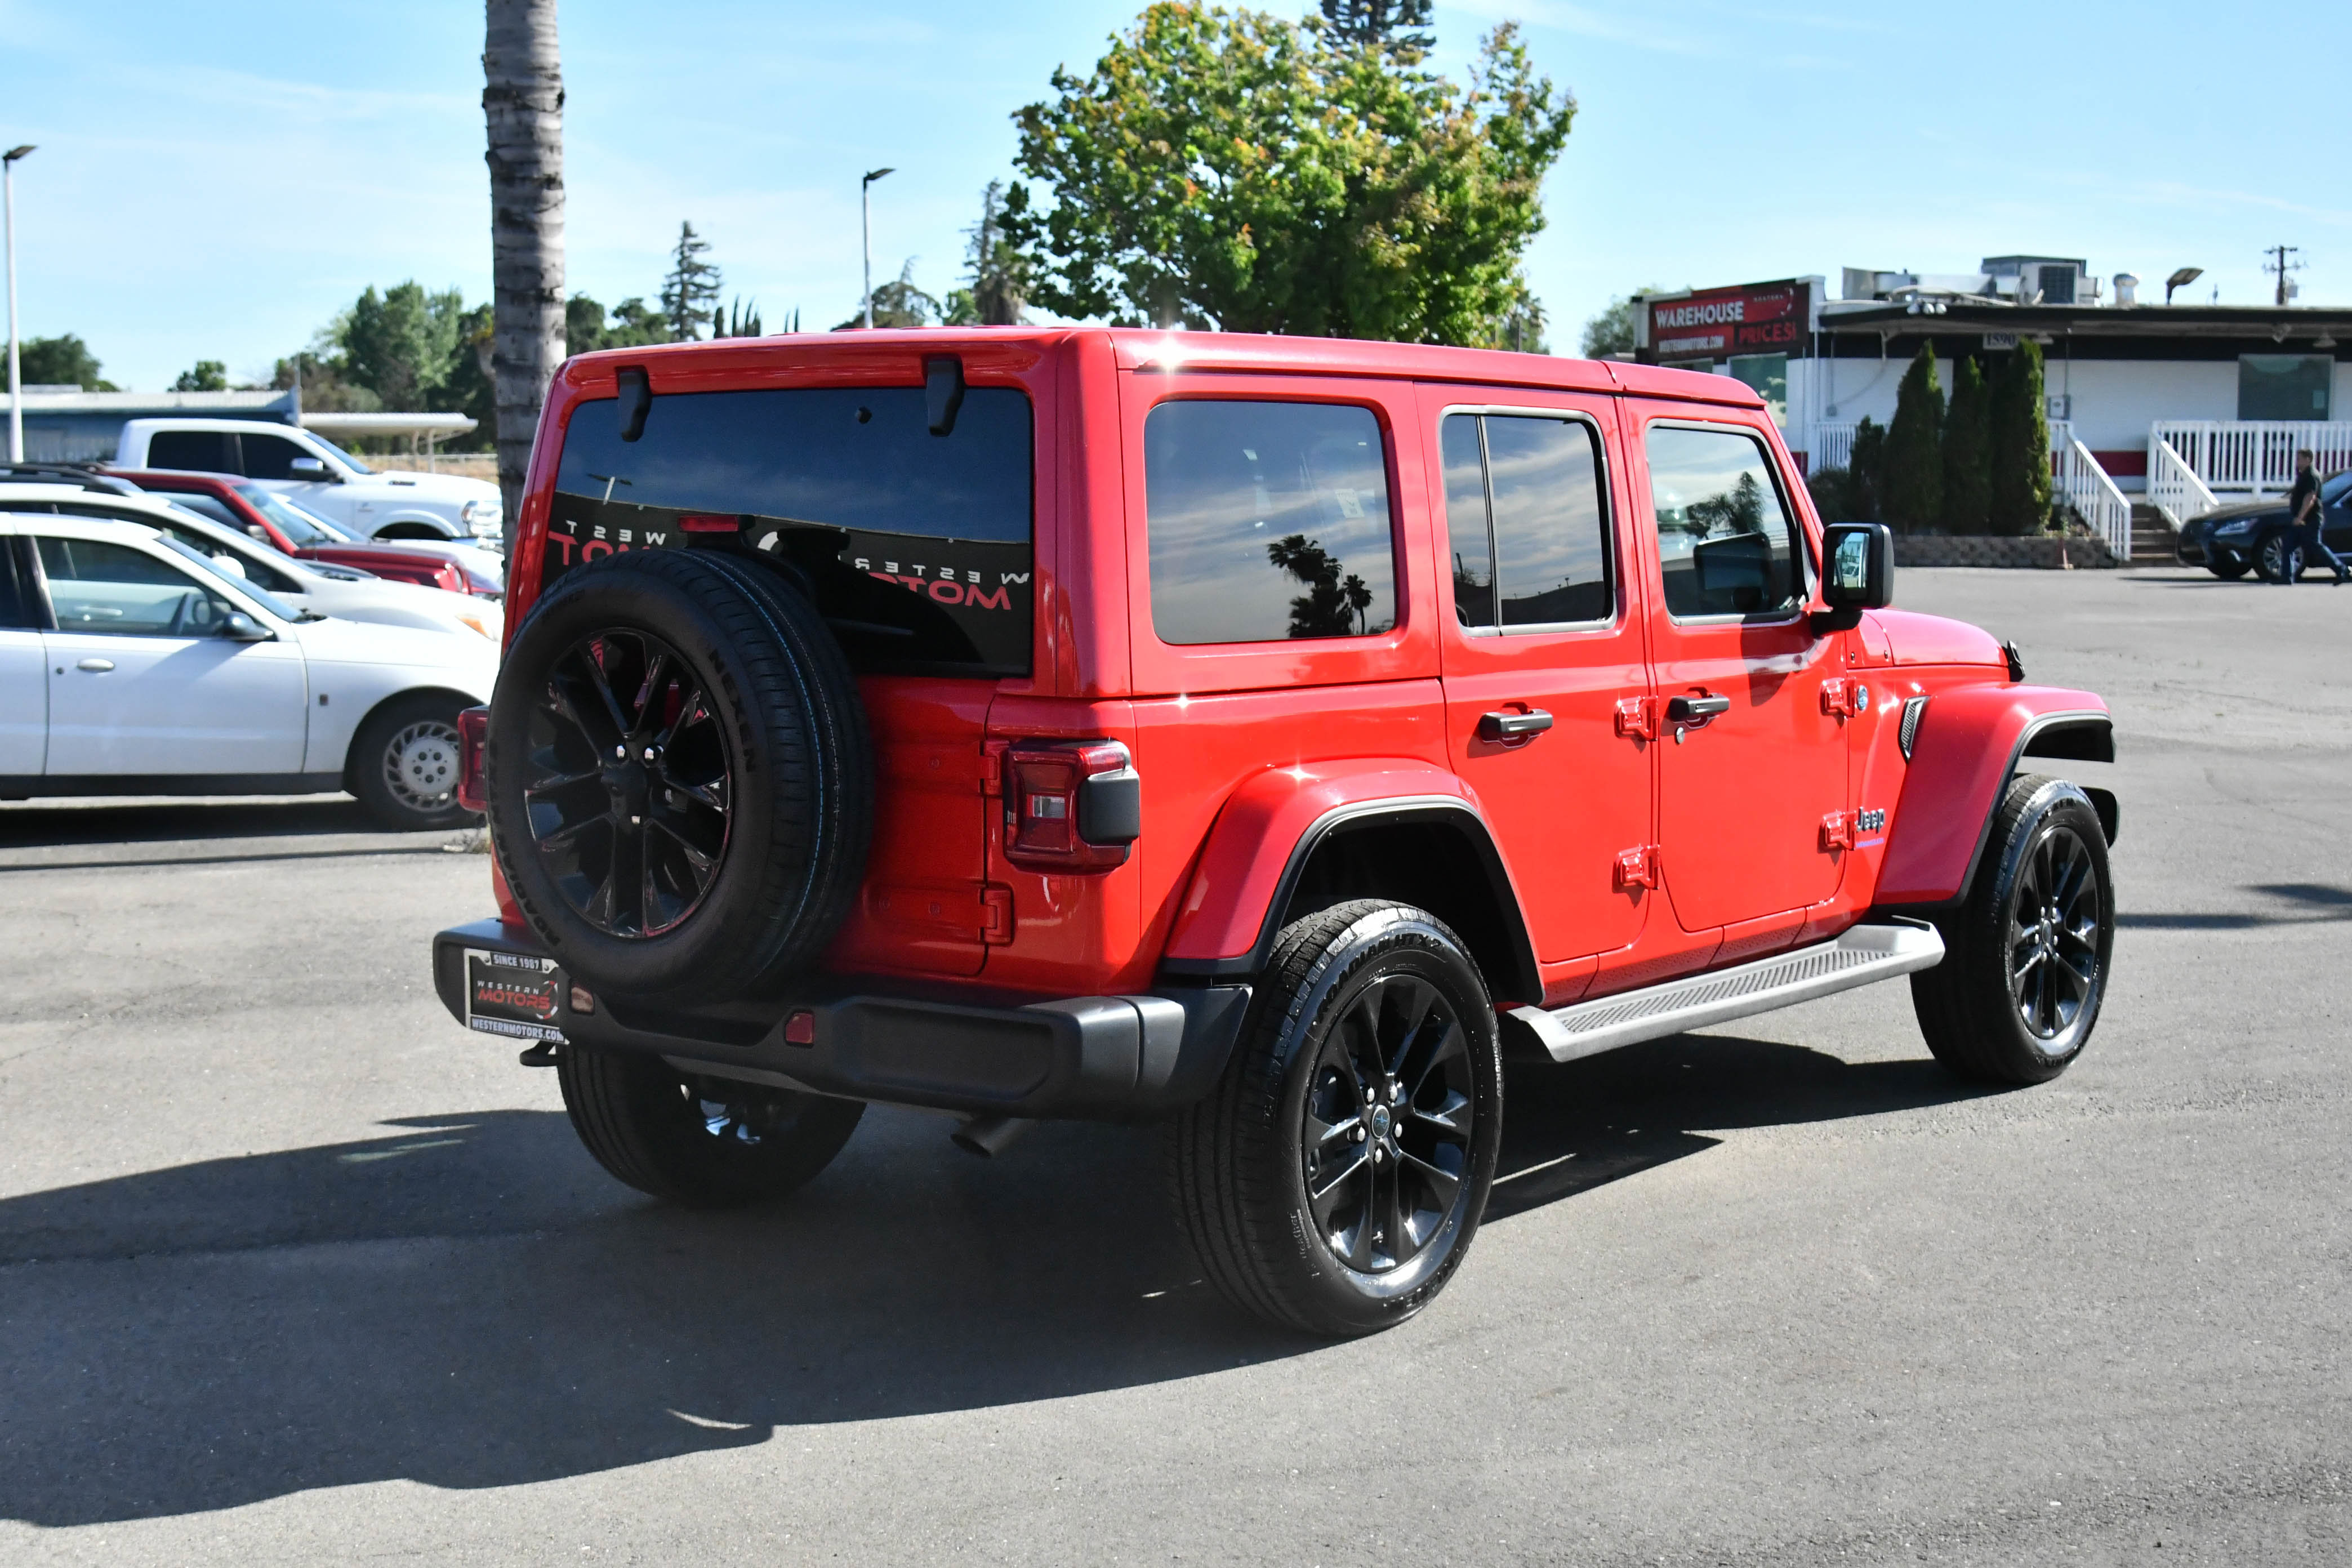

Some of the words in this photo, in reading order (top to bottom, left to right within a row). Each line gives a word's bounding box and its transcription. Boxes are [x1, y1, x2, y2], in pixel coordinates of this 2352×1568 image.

[1655, 300, 1744, 329] WAREHOUSE
[1739, 321, 1796, 344] PRICES!
[1855, 807, 1885, 834] Jeep
[493, 954, 518, 966] SINCE
[520, 958, 540, 969] 1987
[477, 980, 539, 995] WESTERN
[478, 988, 550, 1010] MOTORS
[472, 1018, 564, 1041] WESTERNMOTORS.COM
